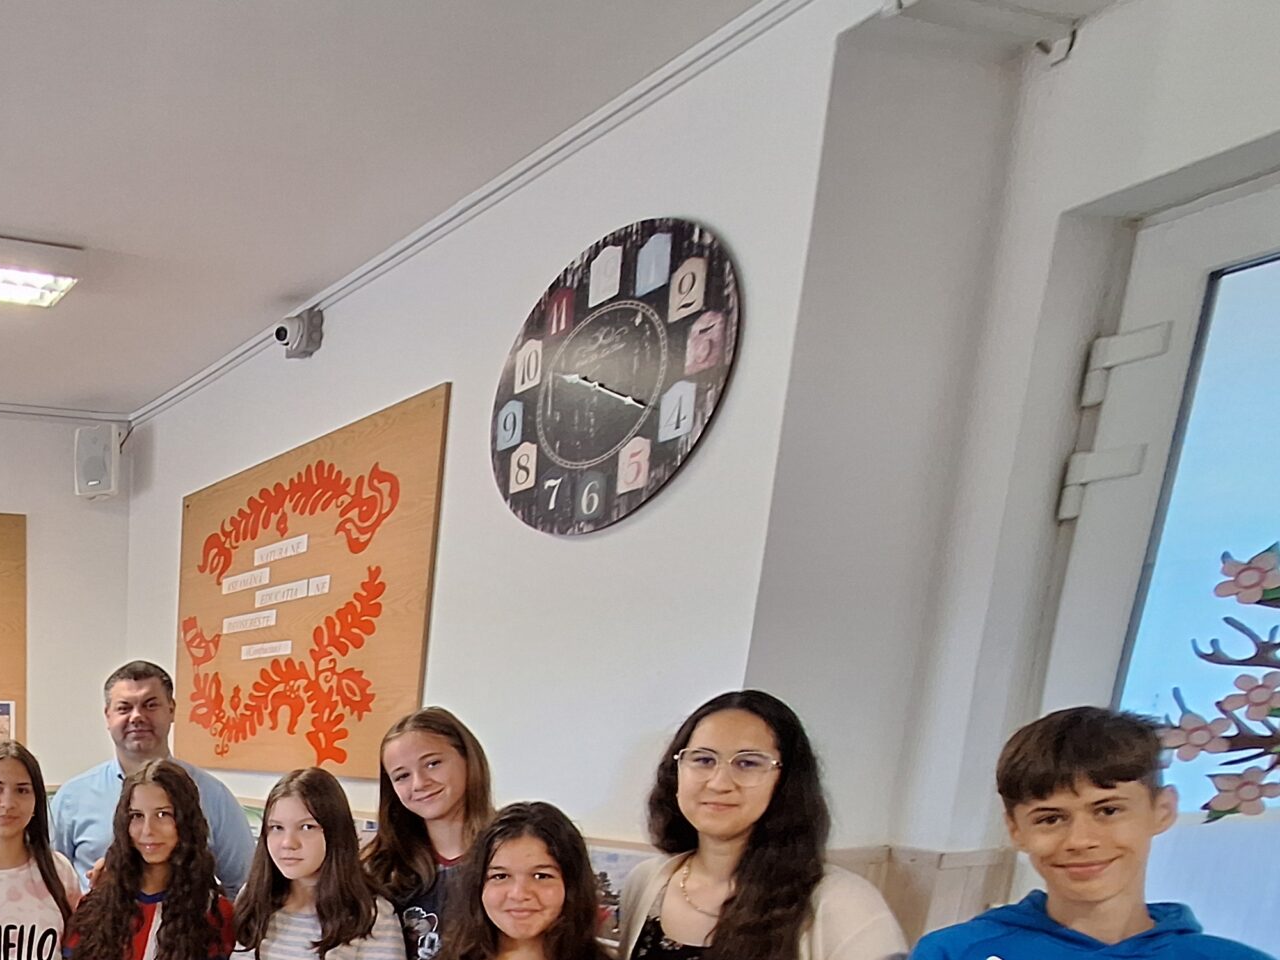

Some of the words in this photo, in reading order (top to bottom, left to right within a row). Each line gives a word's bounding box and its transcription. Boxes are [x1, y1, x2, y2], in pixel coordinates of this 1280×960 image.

[676, 271, 698, 311] 2
[550, 297, 567, 336] 11
[693, 322, 717, 365] 3
[522, 348, 539, 386] 10
[502, 411, 518, 443] 9
[664, 394, 687, 432] 4
[514, 453, 530, 486] 8
[623, 448, 644, 485] 5
[543, 477, 563, 511] 7
[580, 480, 601, 515] 6
